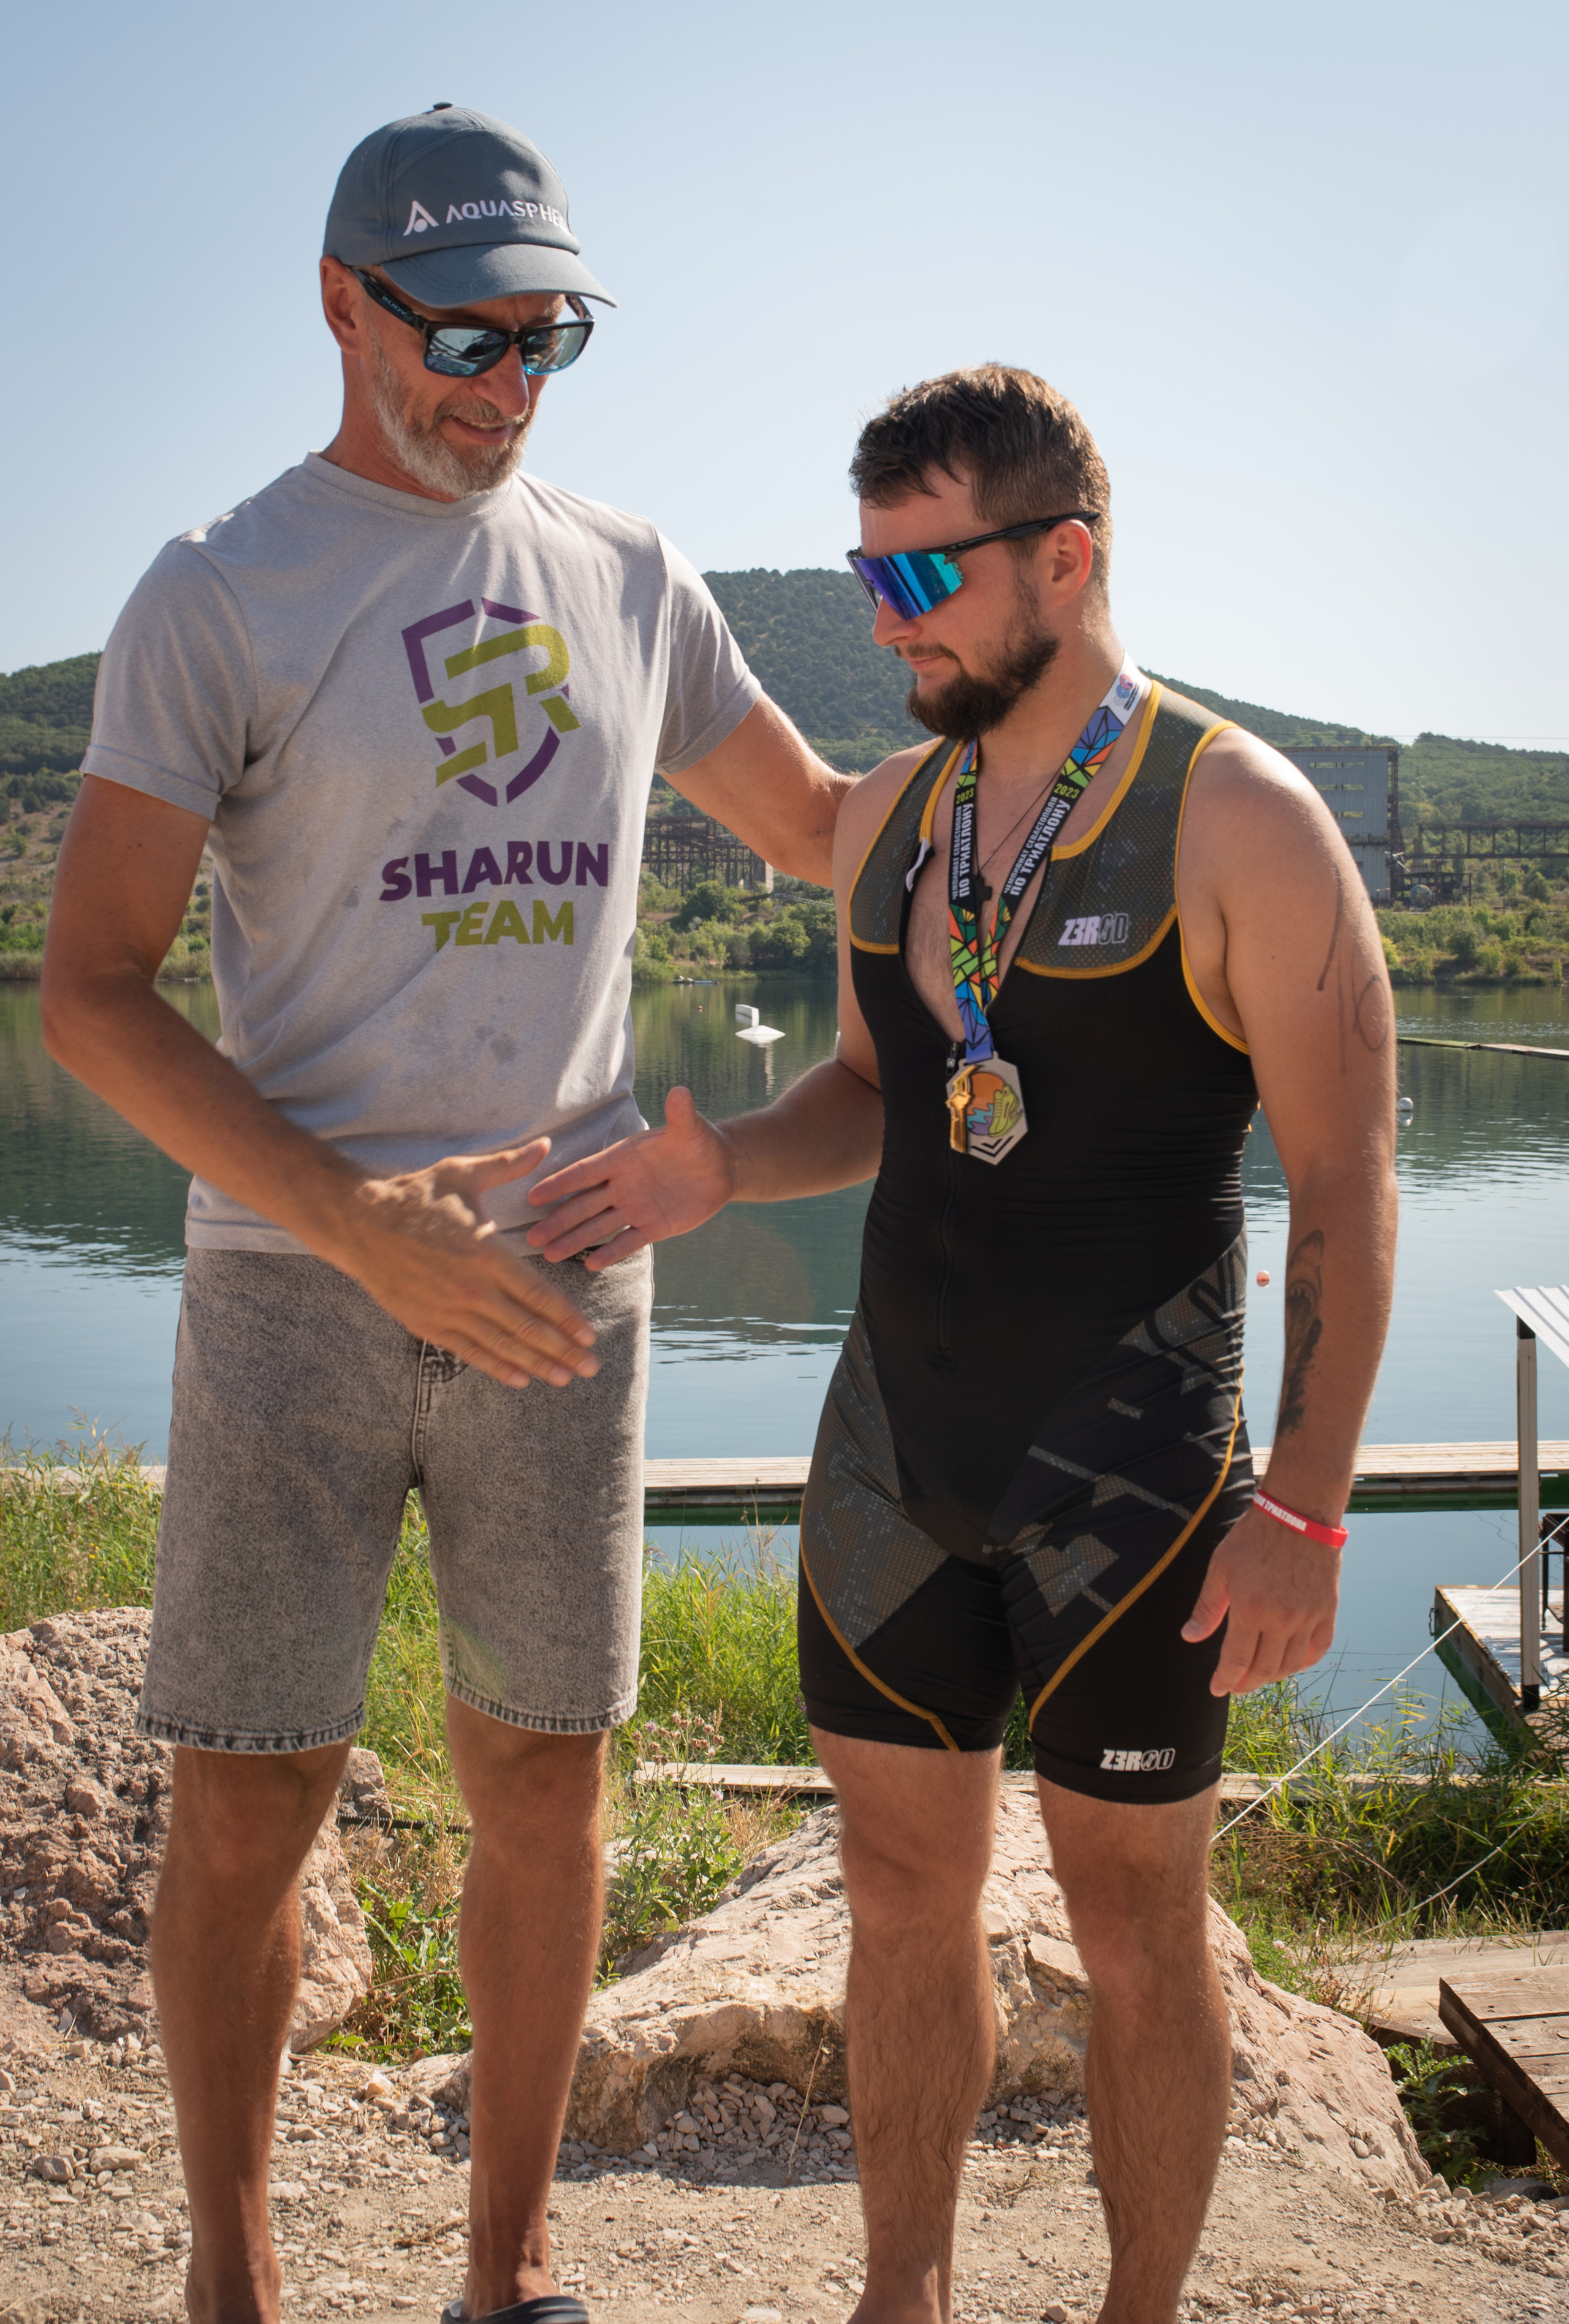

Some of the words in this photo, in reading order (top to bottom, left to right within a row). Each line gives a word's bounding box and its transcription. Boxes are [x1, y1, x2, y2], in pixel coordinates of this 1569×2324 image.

[446, 199, 574, 235] AQUASPHE
[955, 788, 974, 804] 2023
[1054, 783, 1080, 799] 2023
[953, 805, 962, 856] СЕВАСТОПОЛЯ
[960, 803, 974, 877] ТРИАТЛОНУ
[1003, 849, 1030, 894] ЧЕМПИОНАТ
[1025, 796, 1058, 849] СЕВАСТОПОЛЯ
[1009, 877, 1027, 895] ПО
[1020, 799, 1071, 875] ТРИАТЛОНУ
[379, 840, 609, 902] SHARUN
[951, 857, 960, 900] ЧЕМПИОНАТ
[959, 878, 970, 898] ПО
[421, 900, 574, 953] TEAM
